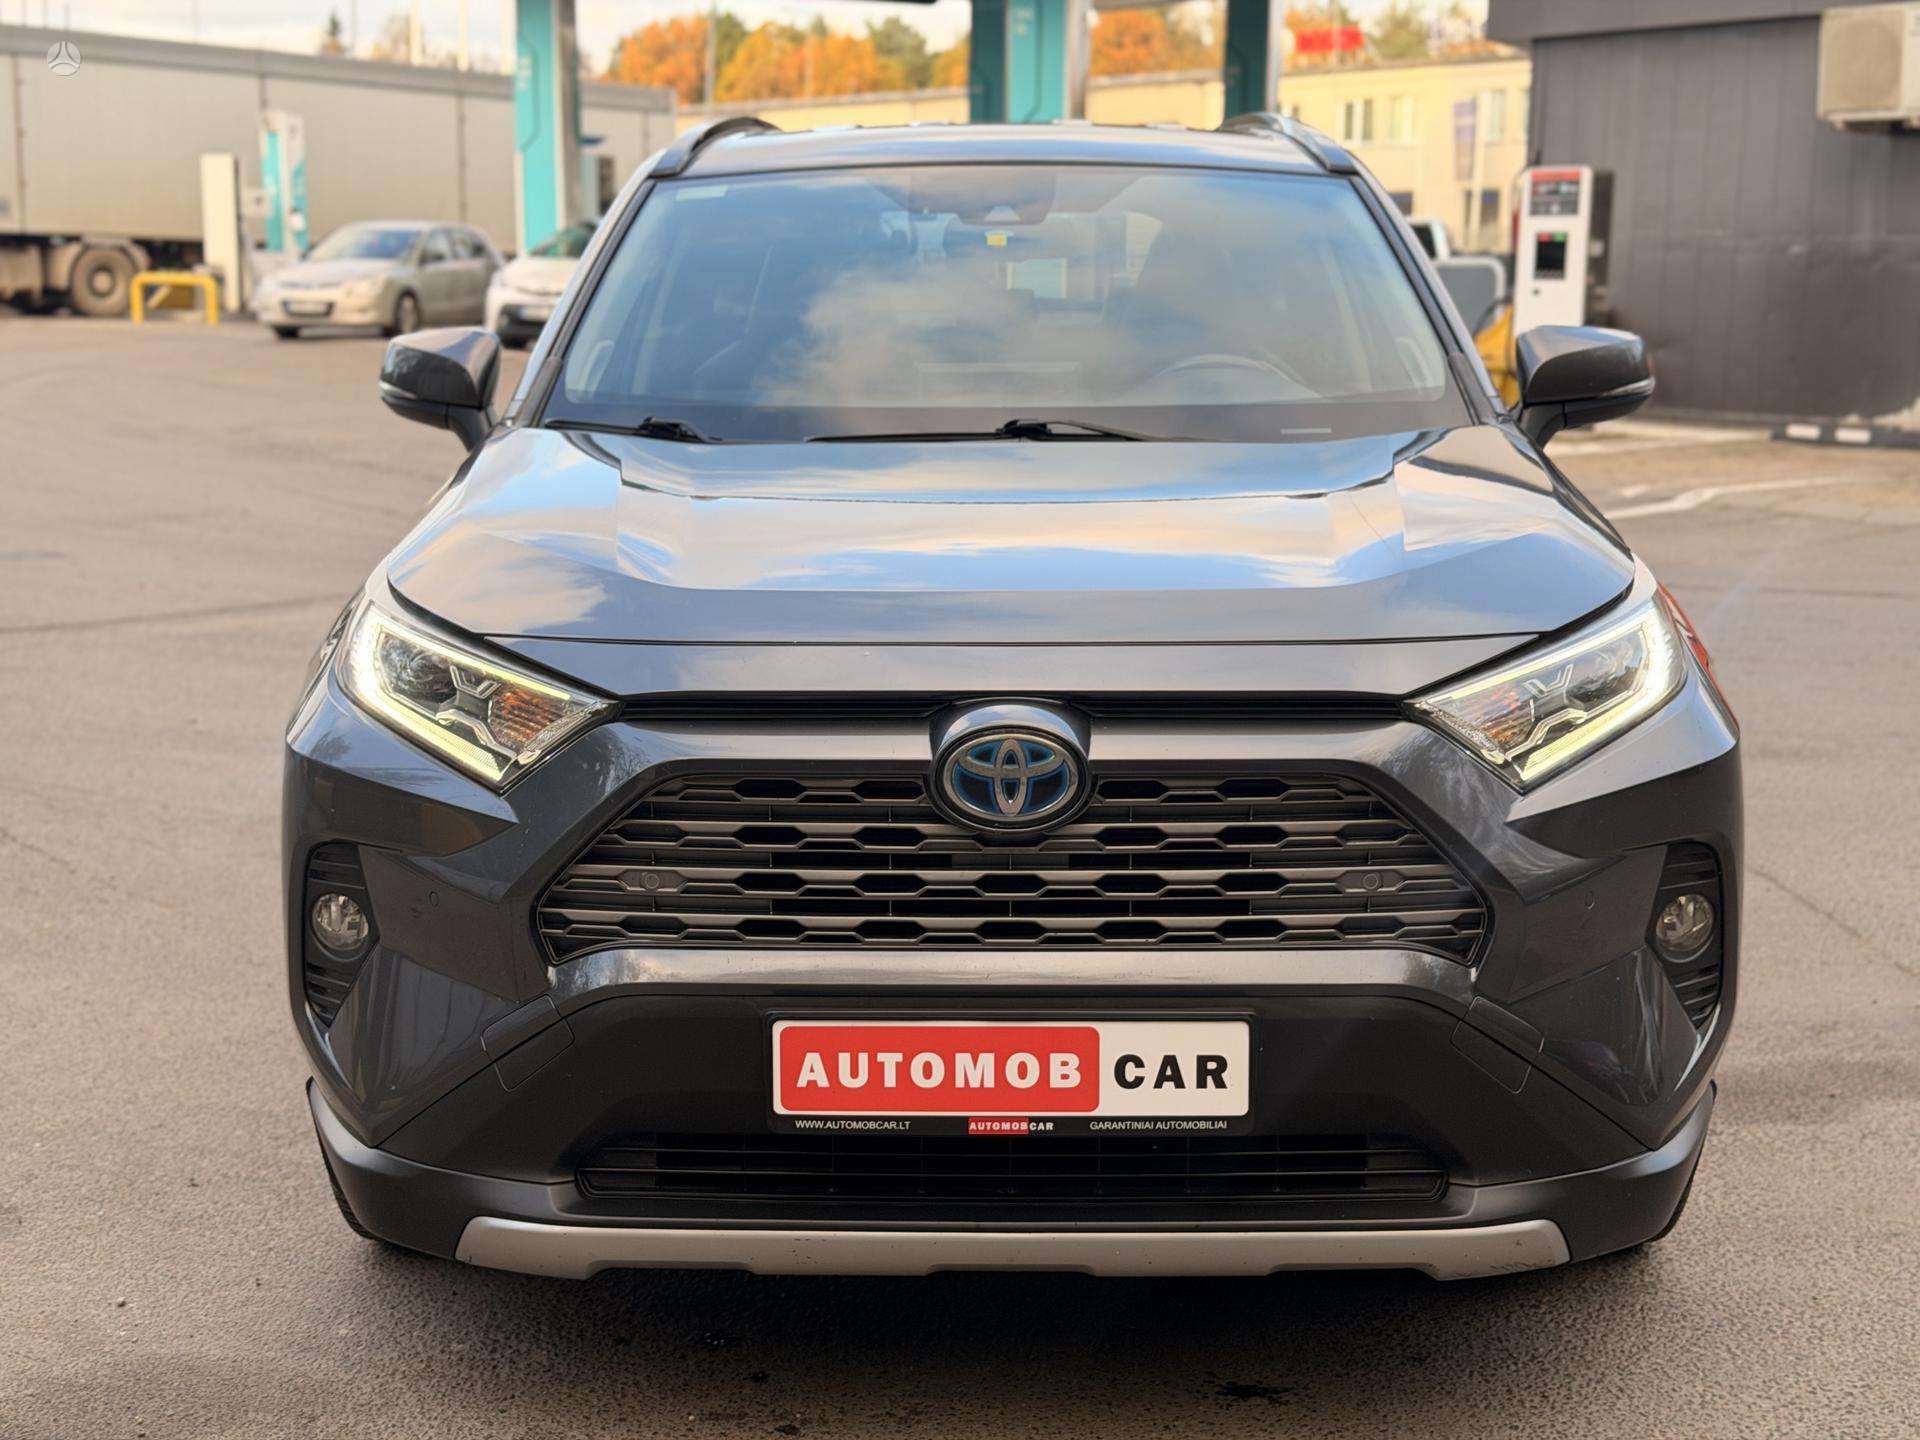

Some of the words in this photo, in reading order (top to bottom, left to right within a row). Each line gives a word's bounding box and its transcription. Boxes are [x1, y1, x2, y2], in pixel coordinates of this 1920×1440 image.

[796, 1051, 1082, 1089] AUTOMOB
[1113, 1053, 1229, 1090] CAR
[794, 1119, 912, 1131] WWW.AUTOMOBCAR.LT
[1089, 1120, 1154, 1131] GARANTINIAI
[1155, 1119, 1228, 1130] AUTOMOBILIAI
